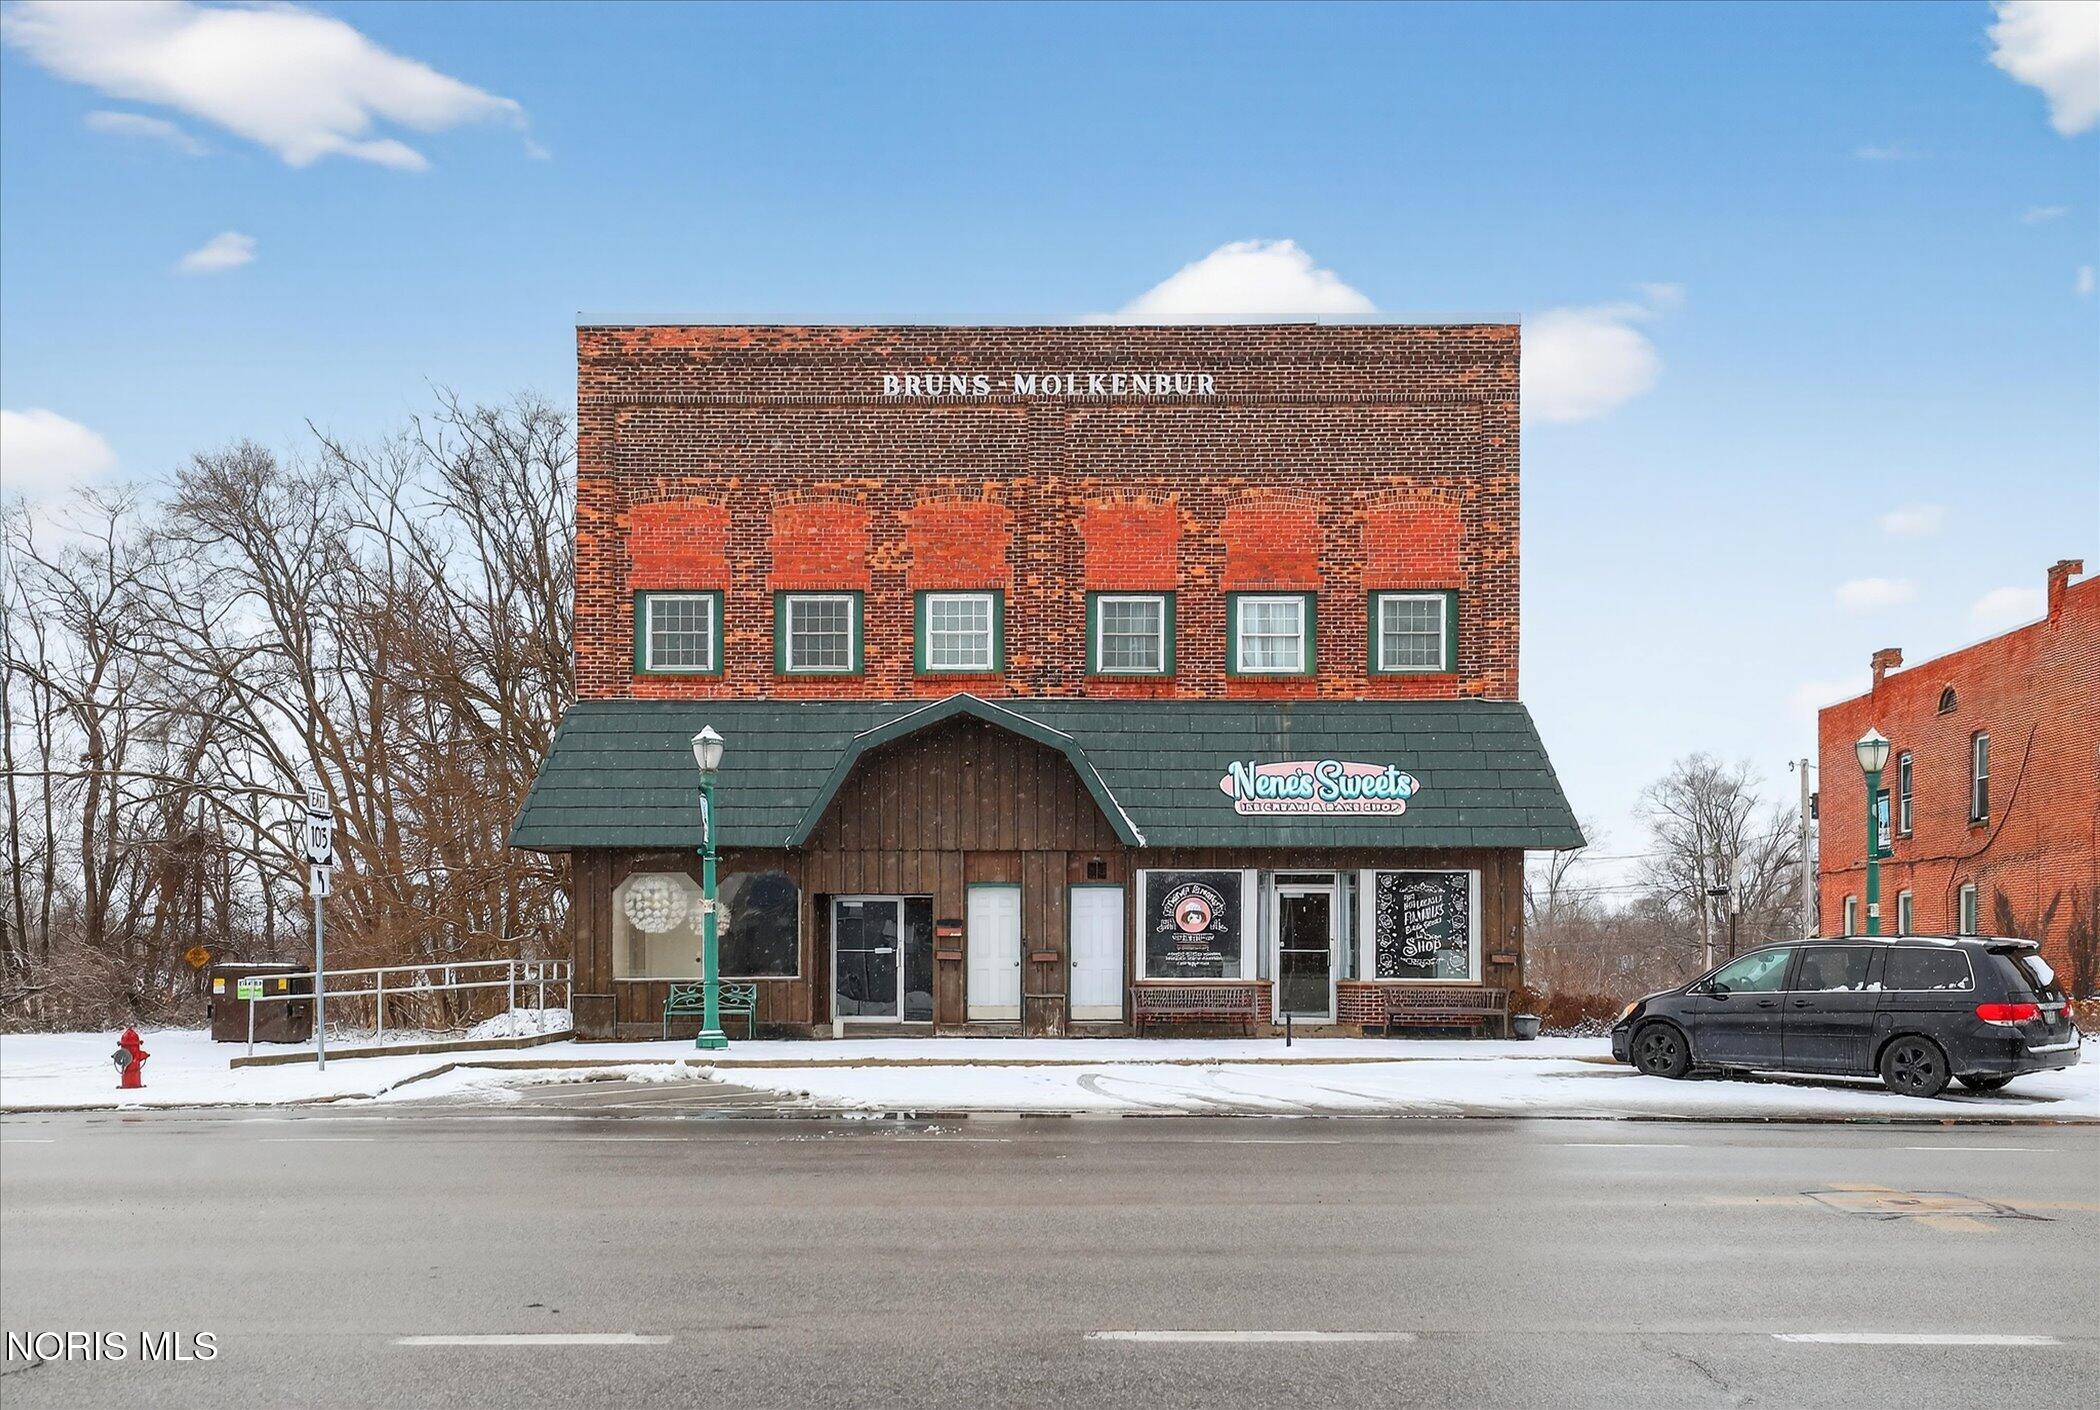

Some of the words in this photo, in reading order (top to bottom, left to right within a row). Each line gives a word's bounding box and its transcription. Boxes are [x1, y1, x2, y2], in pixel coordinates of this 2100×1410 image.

[1227, 760, 1315, 801] Nene's
[1314, 759, 1413, 801] Sweets
[1262, 802, 1309, 813] CREAM
[1402, 937, 1442, 957] SHOP
